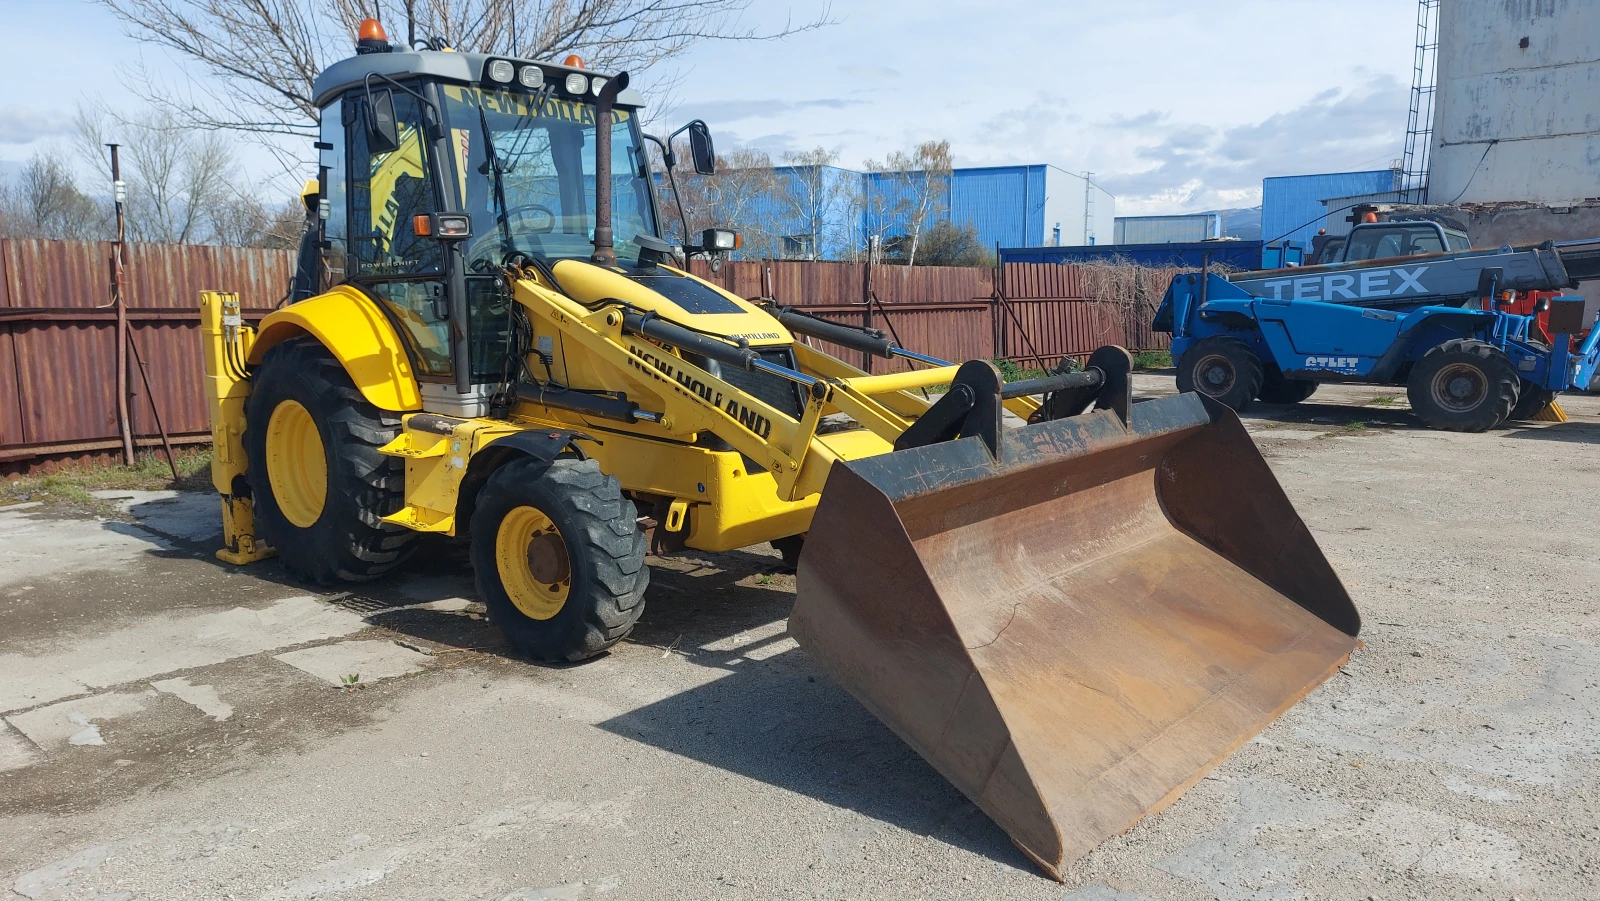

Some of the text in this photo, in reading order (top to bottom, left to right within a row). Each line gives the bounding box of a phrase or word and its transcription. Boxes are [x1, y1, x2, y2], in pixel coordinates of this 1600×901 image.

[460, 88, 519, 115] NEW
[361, 259, 419, 269] POWERSHIFT
[1264, 266, 1429, 301] TEREX
[627, 345, 673, 384] NEW
[1305, 356, 1358, 368] ATLET
